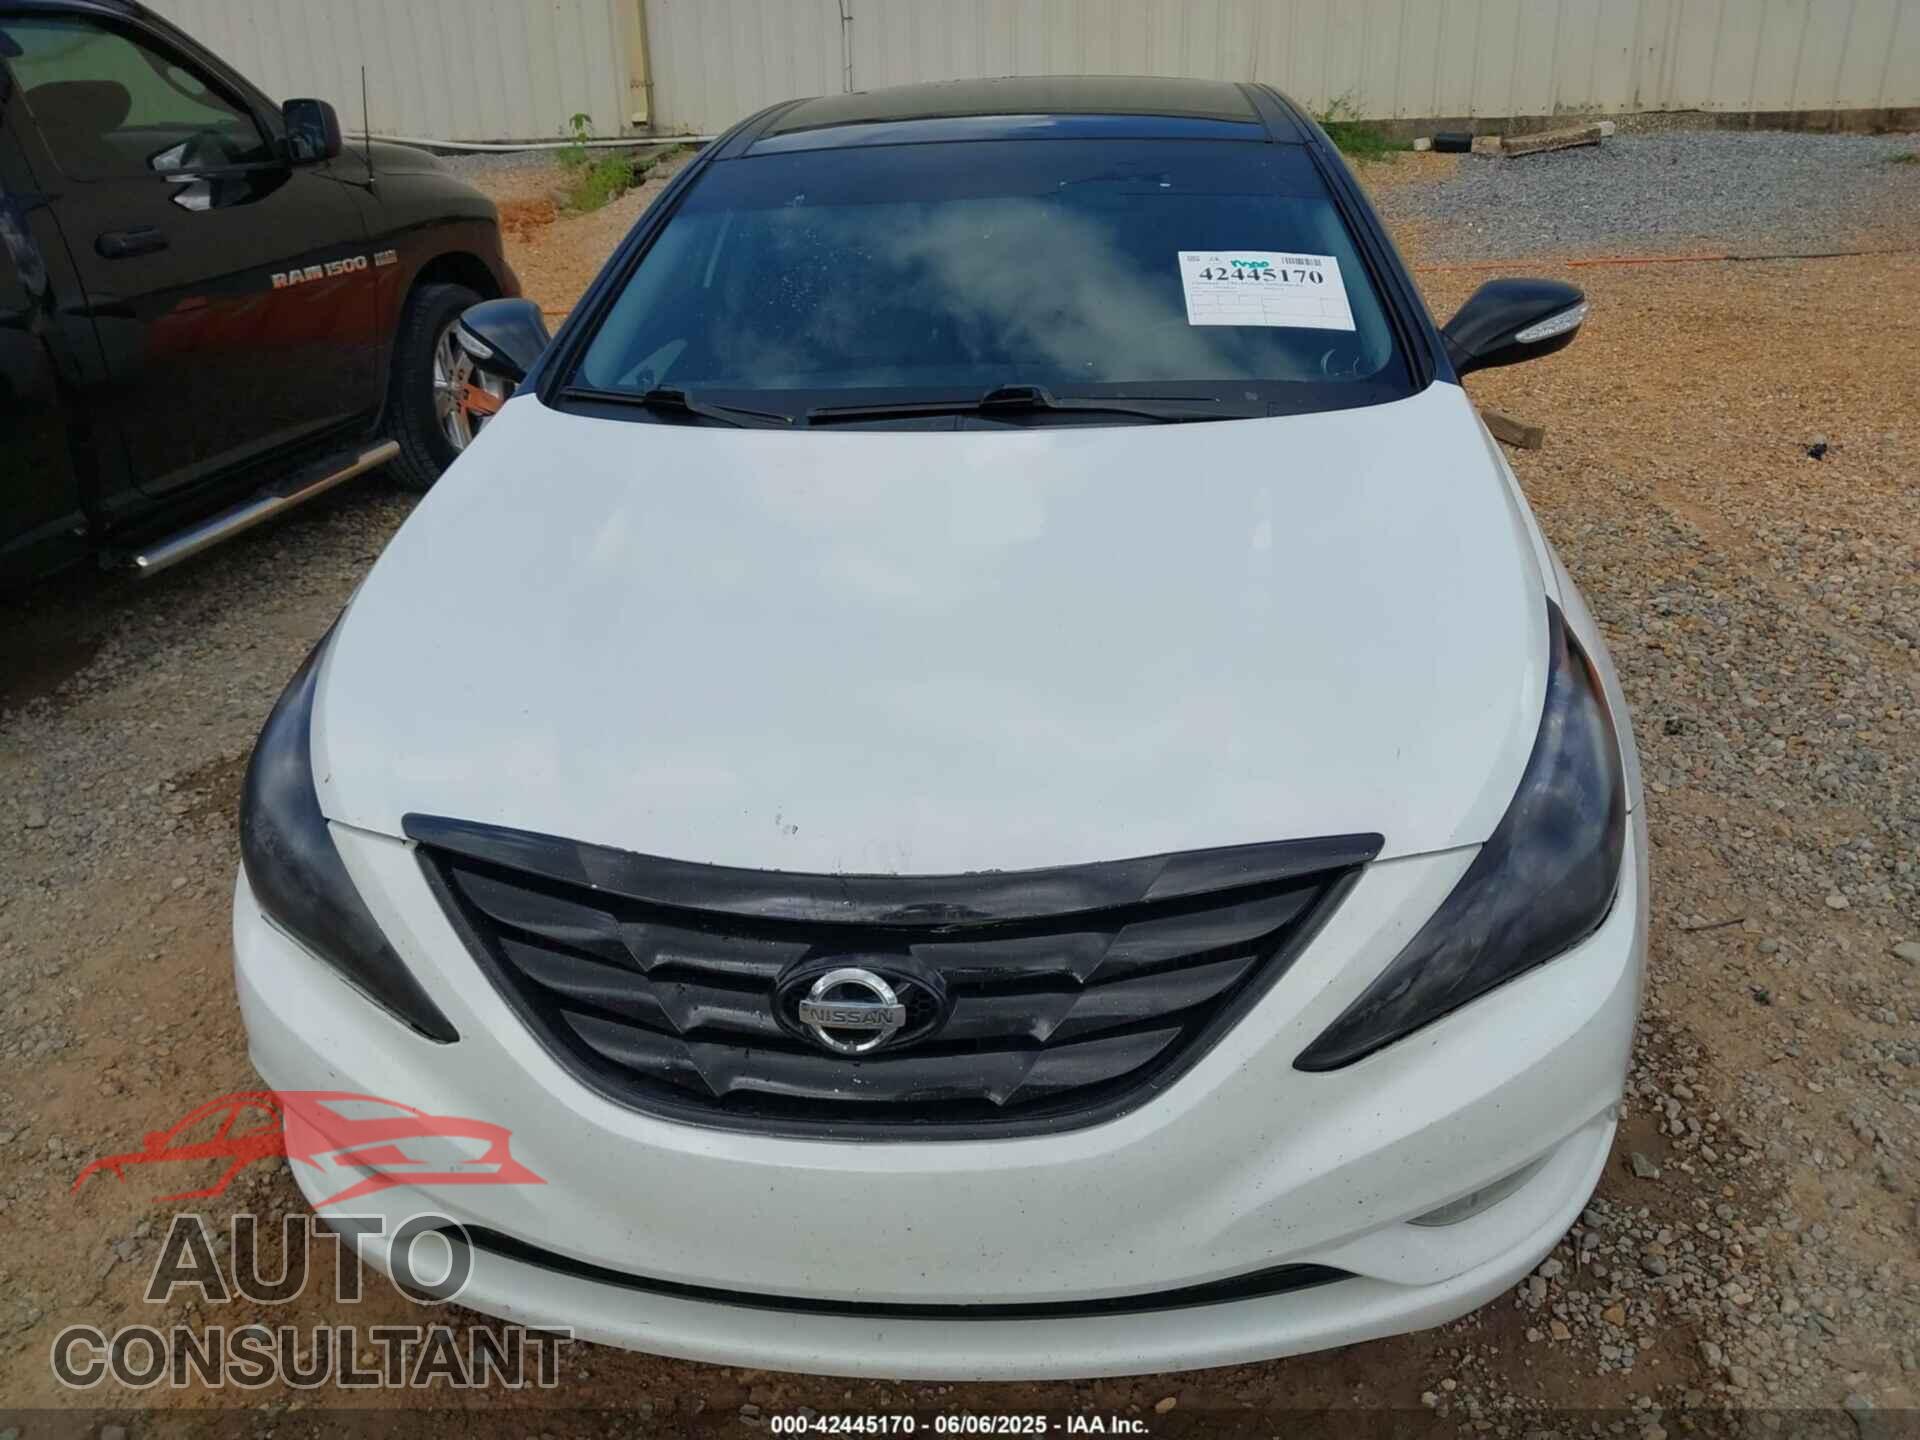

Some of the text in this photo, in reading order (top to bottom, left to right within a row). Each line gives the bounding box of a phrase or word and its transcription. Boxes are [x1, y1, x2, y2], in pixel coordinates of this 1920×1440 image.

[271, 265, 324, 288] RAM
[325, 256, 368, 276] 1500
[1199, 267, 1324, 284] 42445170
[810, 1008, 894, 1024] NISSAN
